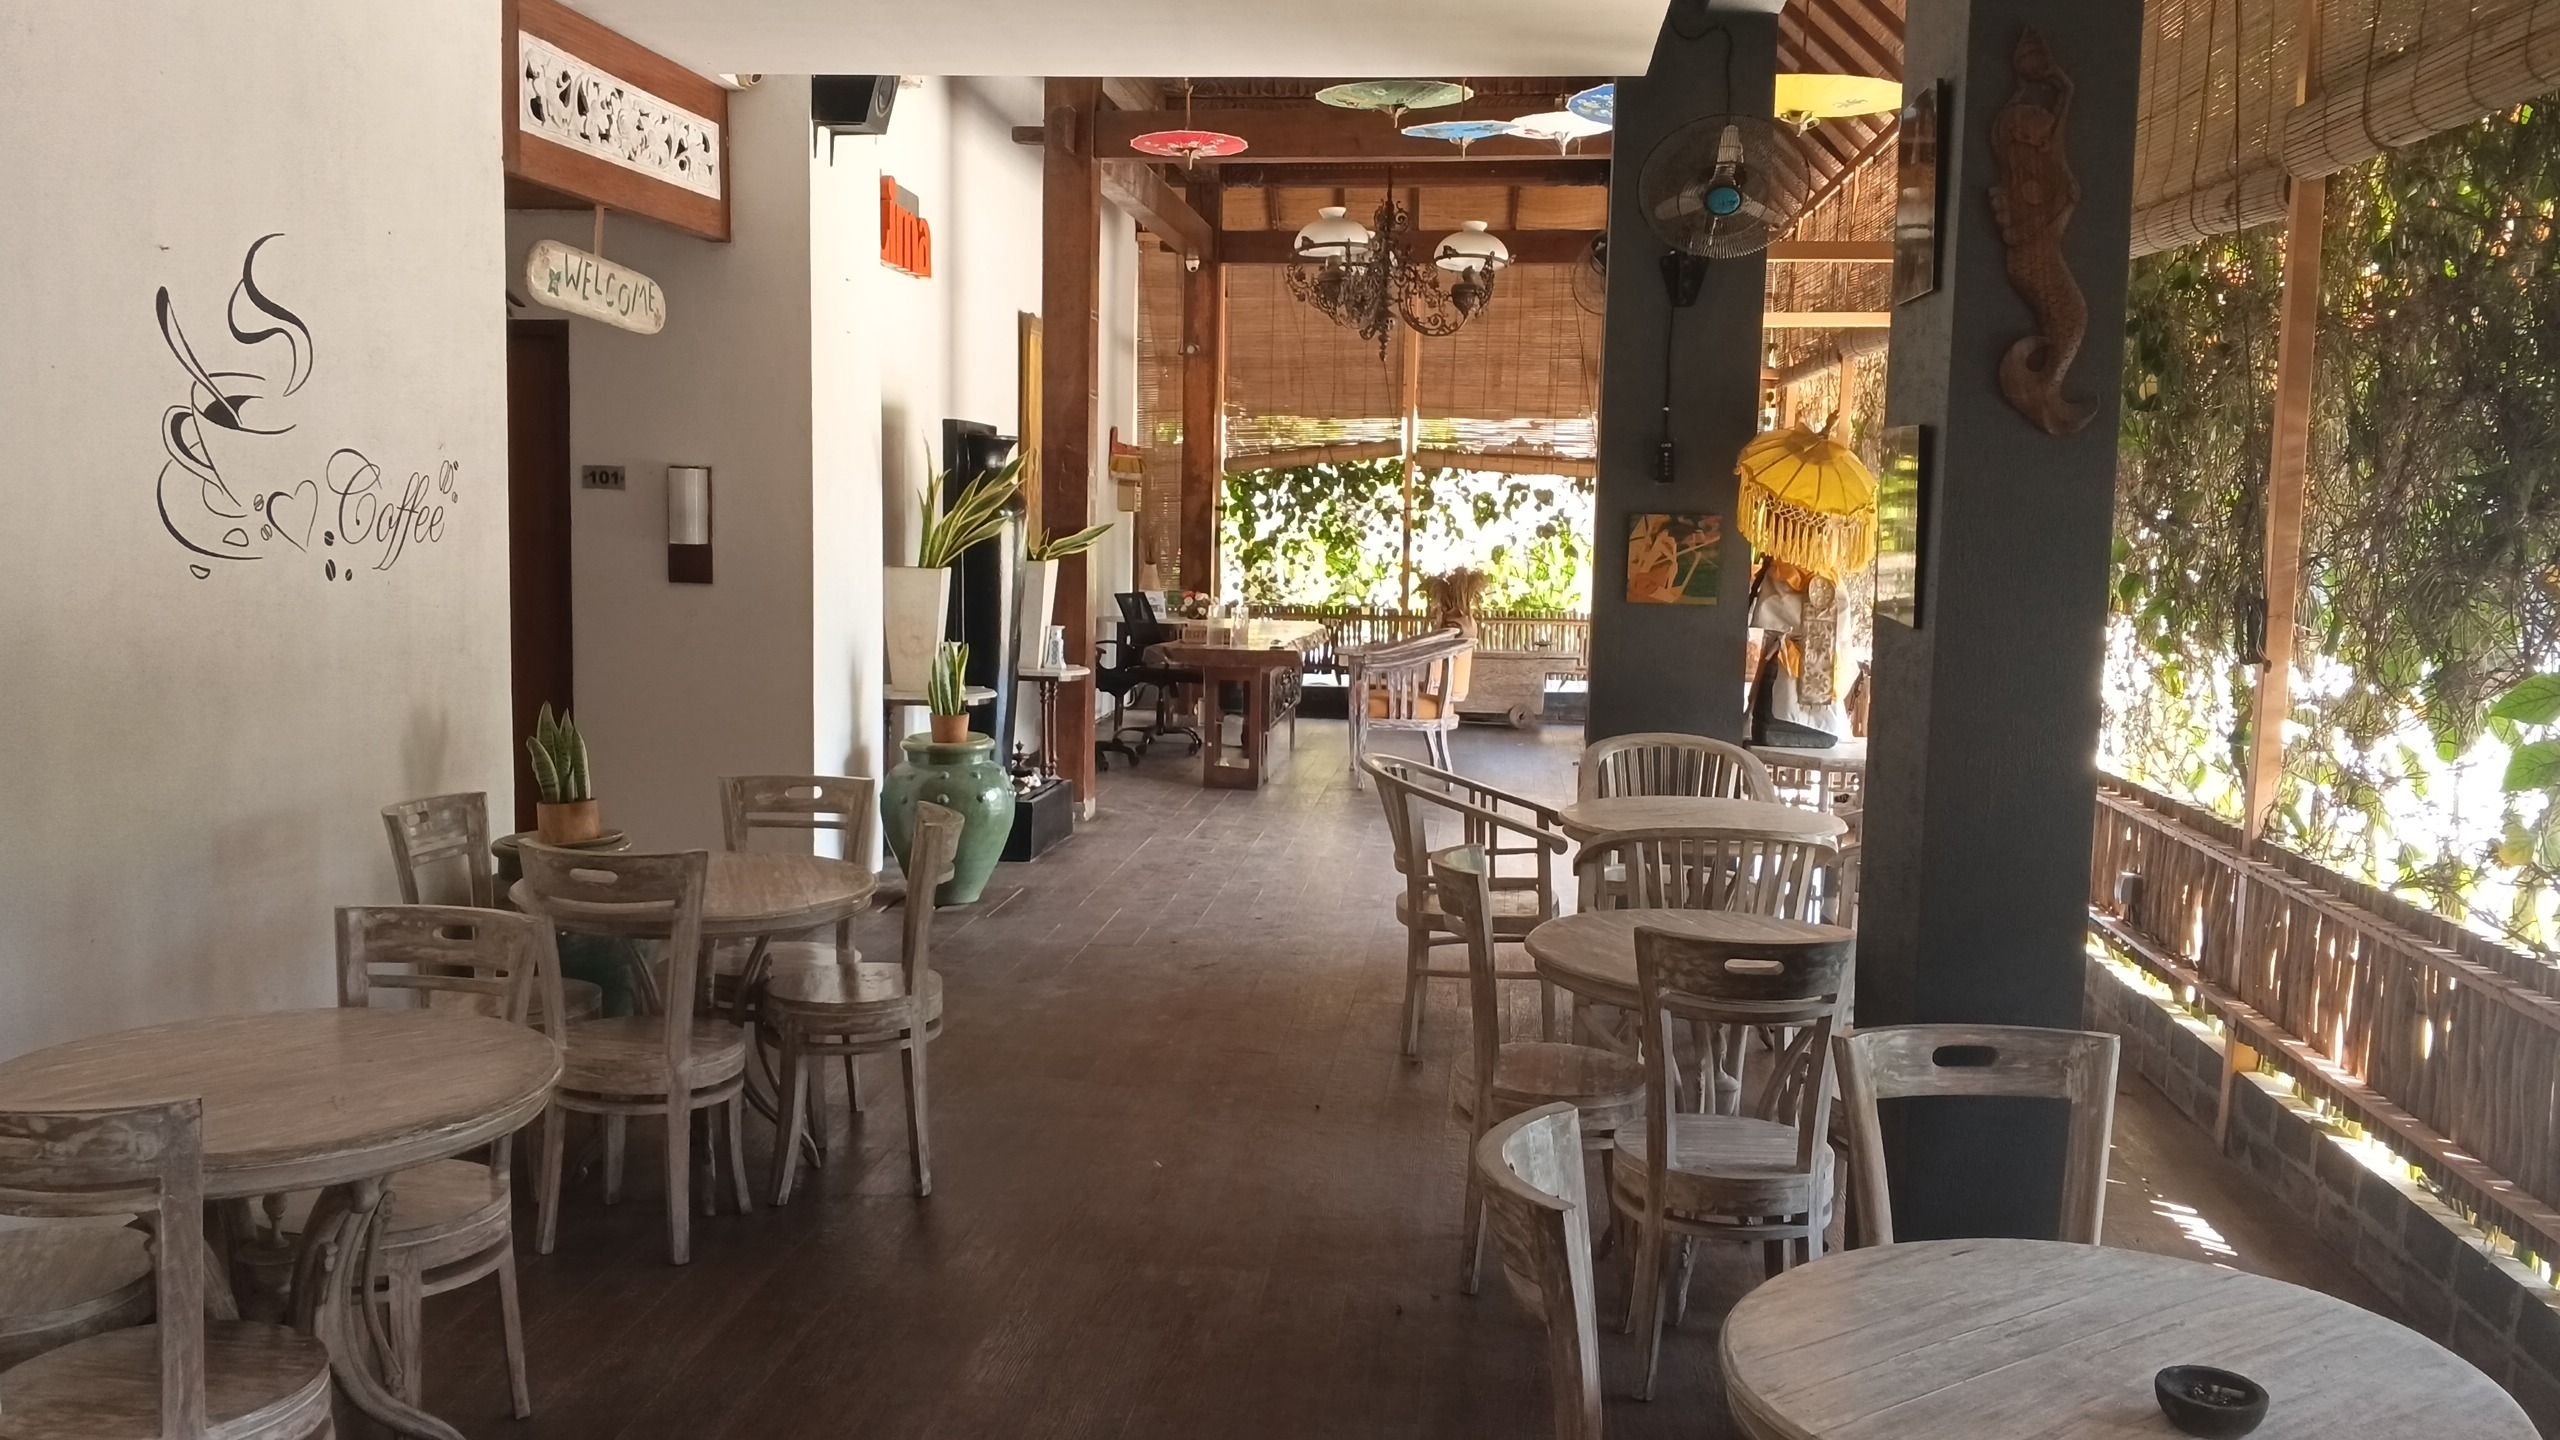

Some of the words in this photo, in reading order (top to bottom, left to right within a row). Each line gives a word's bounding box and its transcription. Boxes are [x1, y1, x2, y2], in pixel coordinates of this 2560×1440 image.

[564, 252, 656, 317] WELCOME
[326, 448, 446, 571] Coffee
[588, 470, 620, 485] 101
